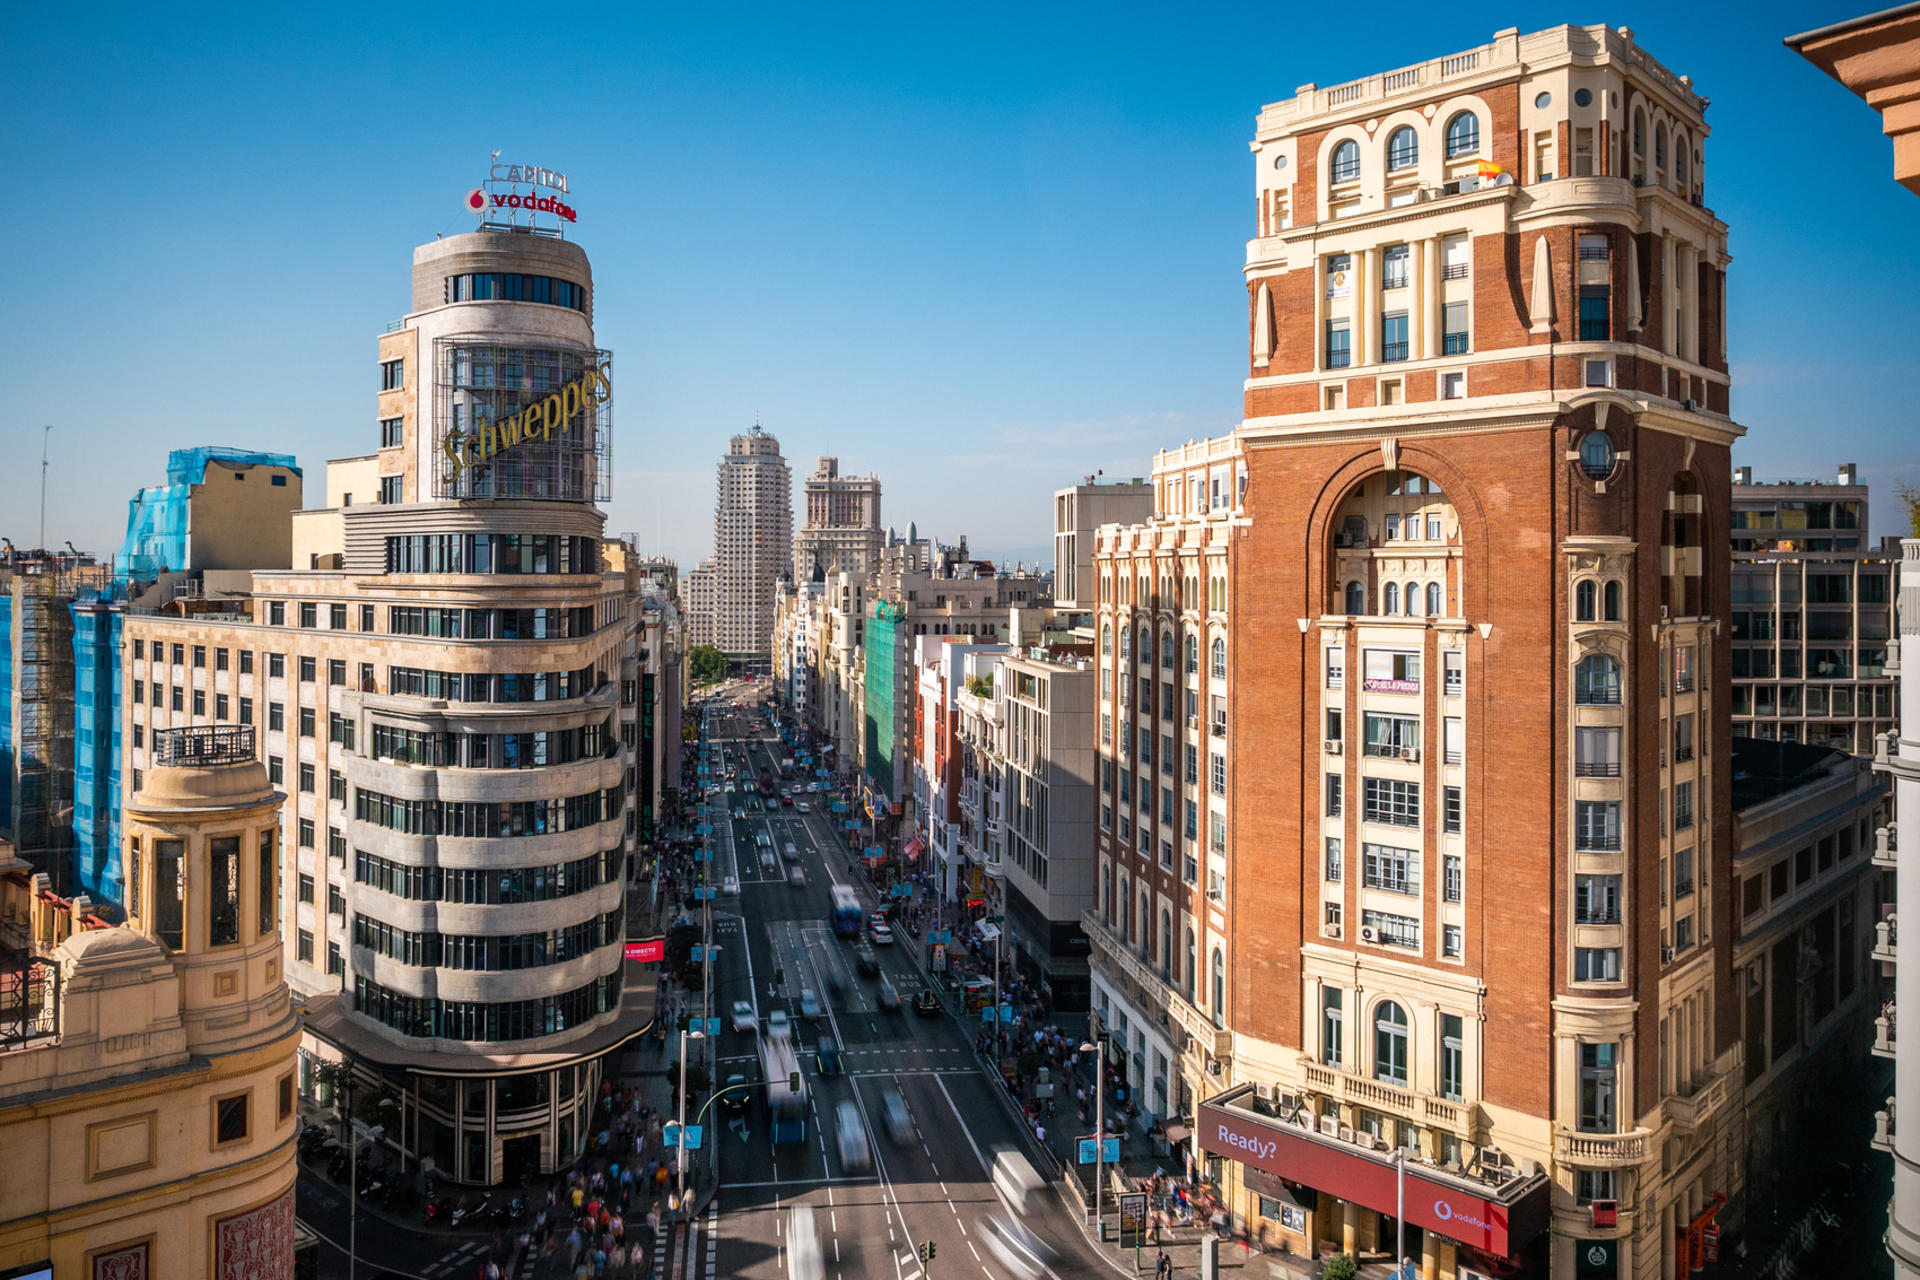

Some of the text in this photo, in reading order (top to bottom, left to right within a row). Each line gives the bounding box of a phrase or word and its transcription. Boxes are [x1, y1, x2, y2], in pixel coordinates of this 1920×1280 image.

[490, 164, 567, 193] CAPITOL
[443, 362, 611, 485] Schweppes
[642, 678, 653, 841] HOTEL REX
[1218, 1124, 1277, 1159] Ready?
[1453, 1212, 1492, 1232] vodafone
